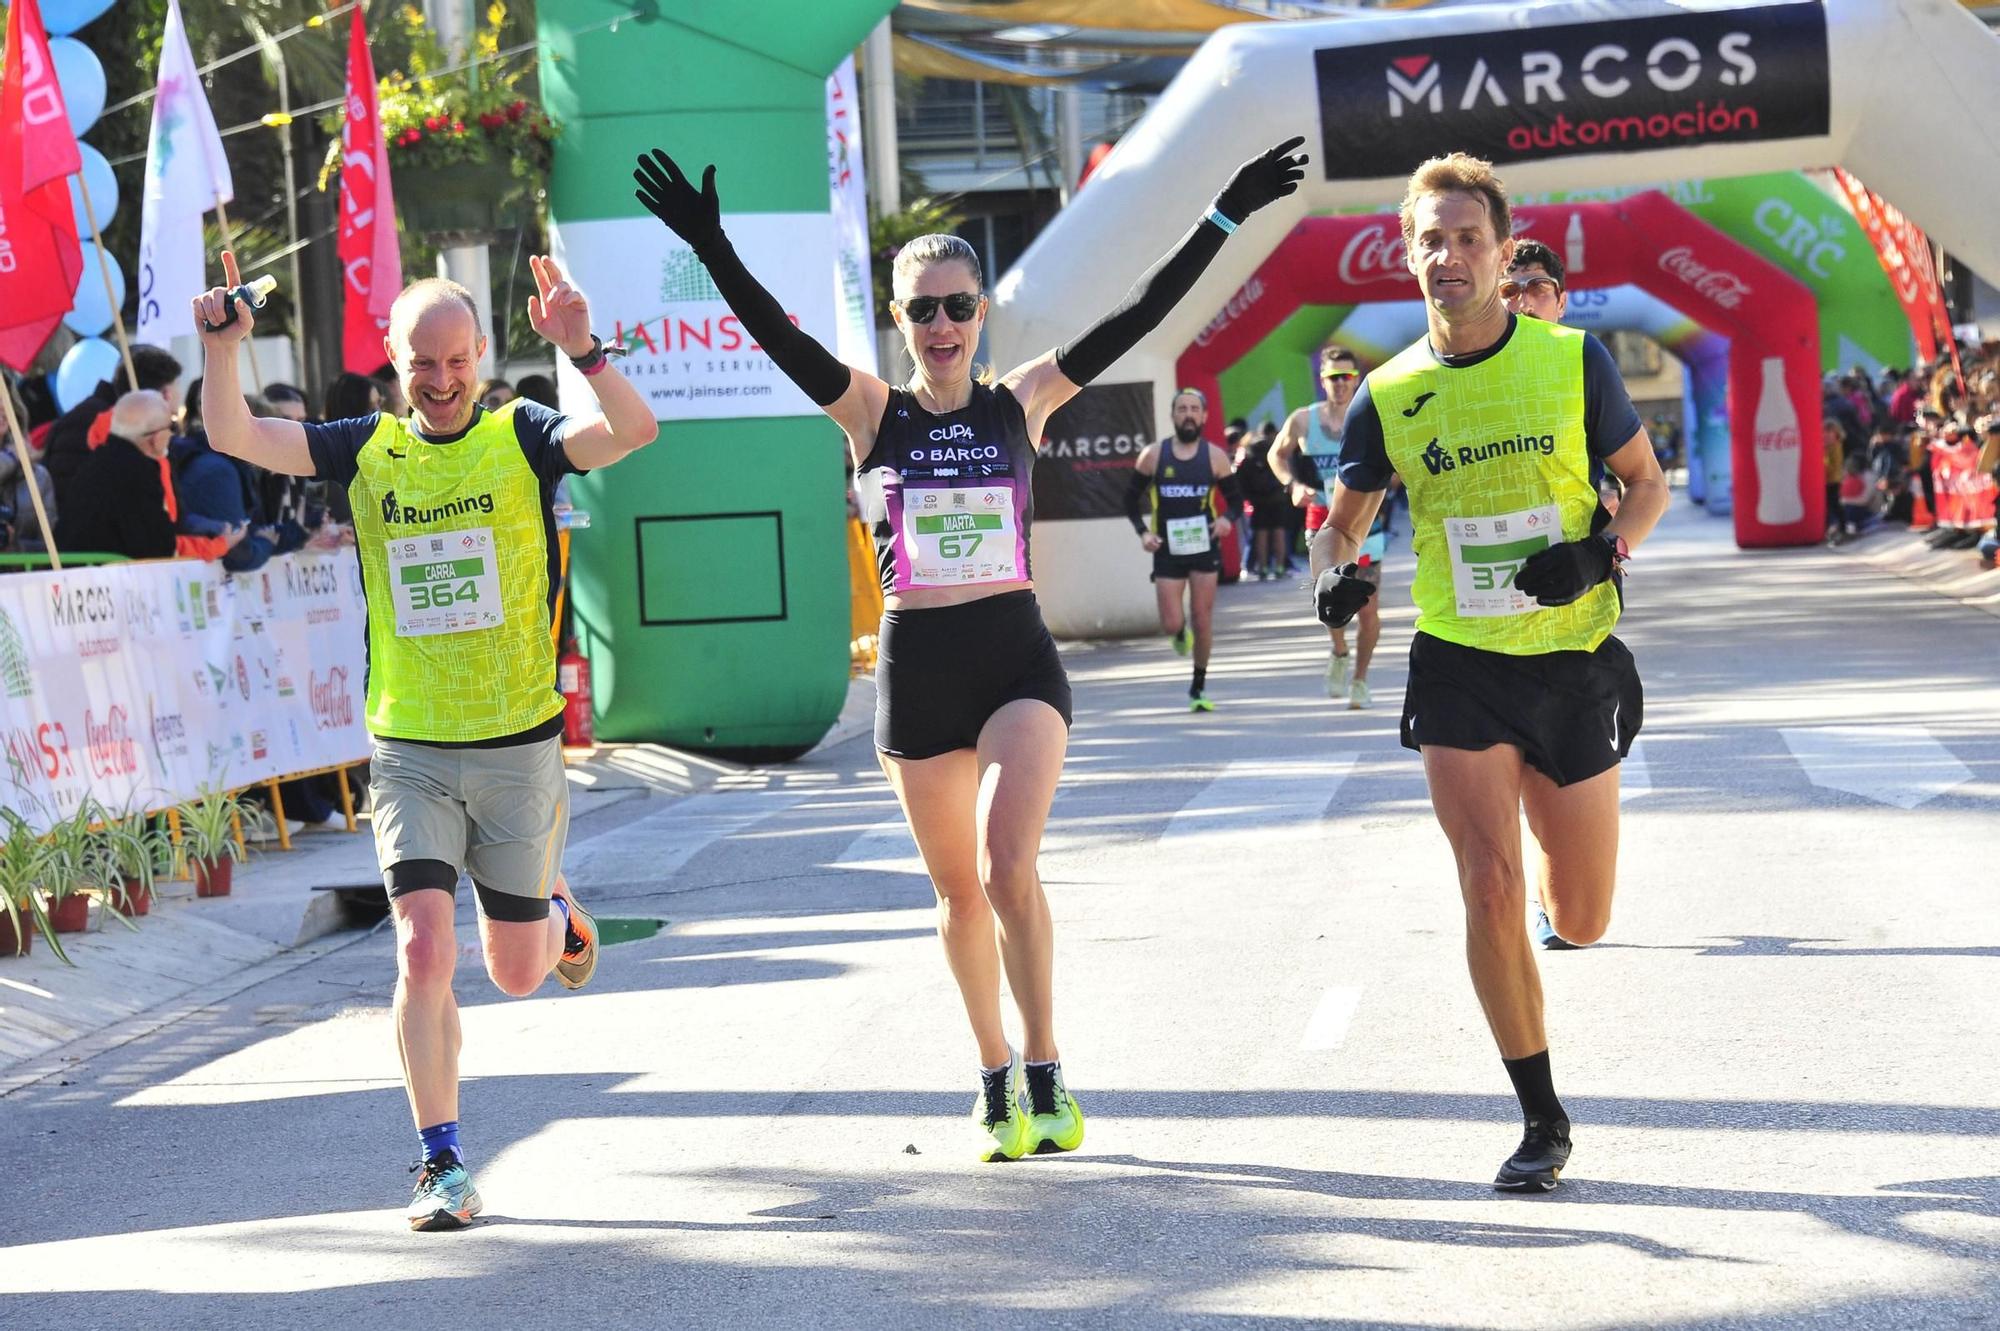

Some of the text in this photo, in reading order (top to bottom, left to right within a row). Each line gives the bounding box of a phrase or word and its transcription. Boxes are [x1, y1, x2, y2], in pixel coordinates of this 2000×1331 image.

[1386, 32, 1757, 118] MARCOS
[1507, 102, 1759, 151] automoción
[1754, 196, 1846, 279] CRC
[624, 363, 669, 376] BRAS
[651, 384, 772, 400] www.jainser.com
[929, 424, 974, 441] CUPA
[1040, 433, 1146, 458] MARCOS
[910, 446, 998, 461] O BARCO
[1458, 434, 1554, 466] Running
[403, 493, 494, 524] Running
[943, 515, 976, 531] MARTA
[939, 533, 983, 558] 67
[425, 563, 456, 580] CARRA
[1472, 563, 1526, 591] 37
[52, 584, 115, 627] MARCOS
[409, 580, 479, 610] 364
